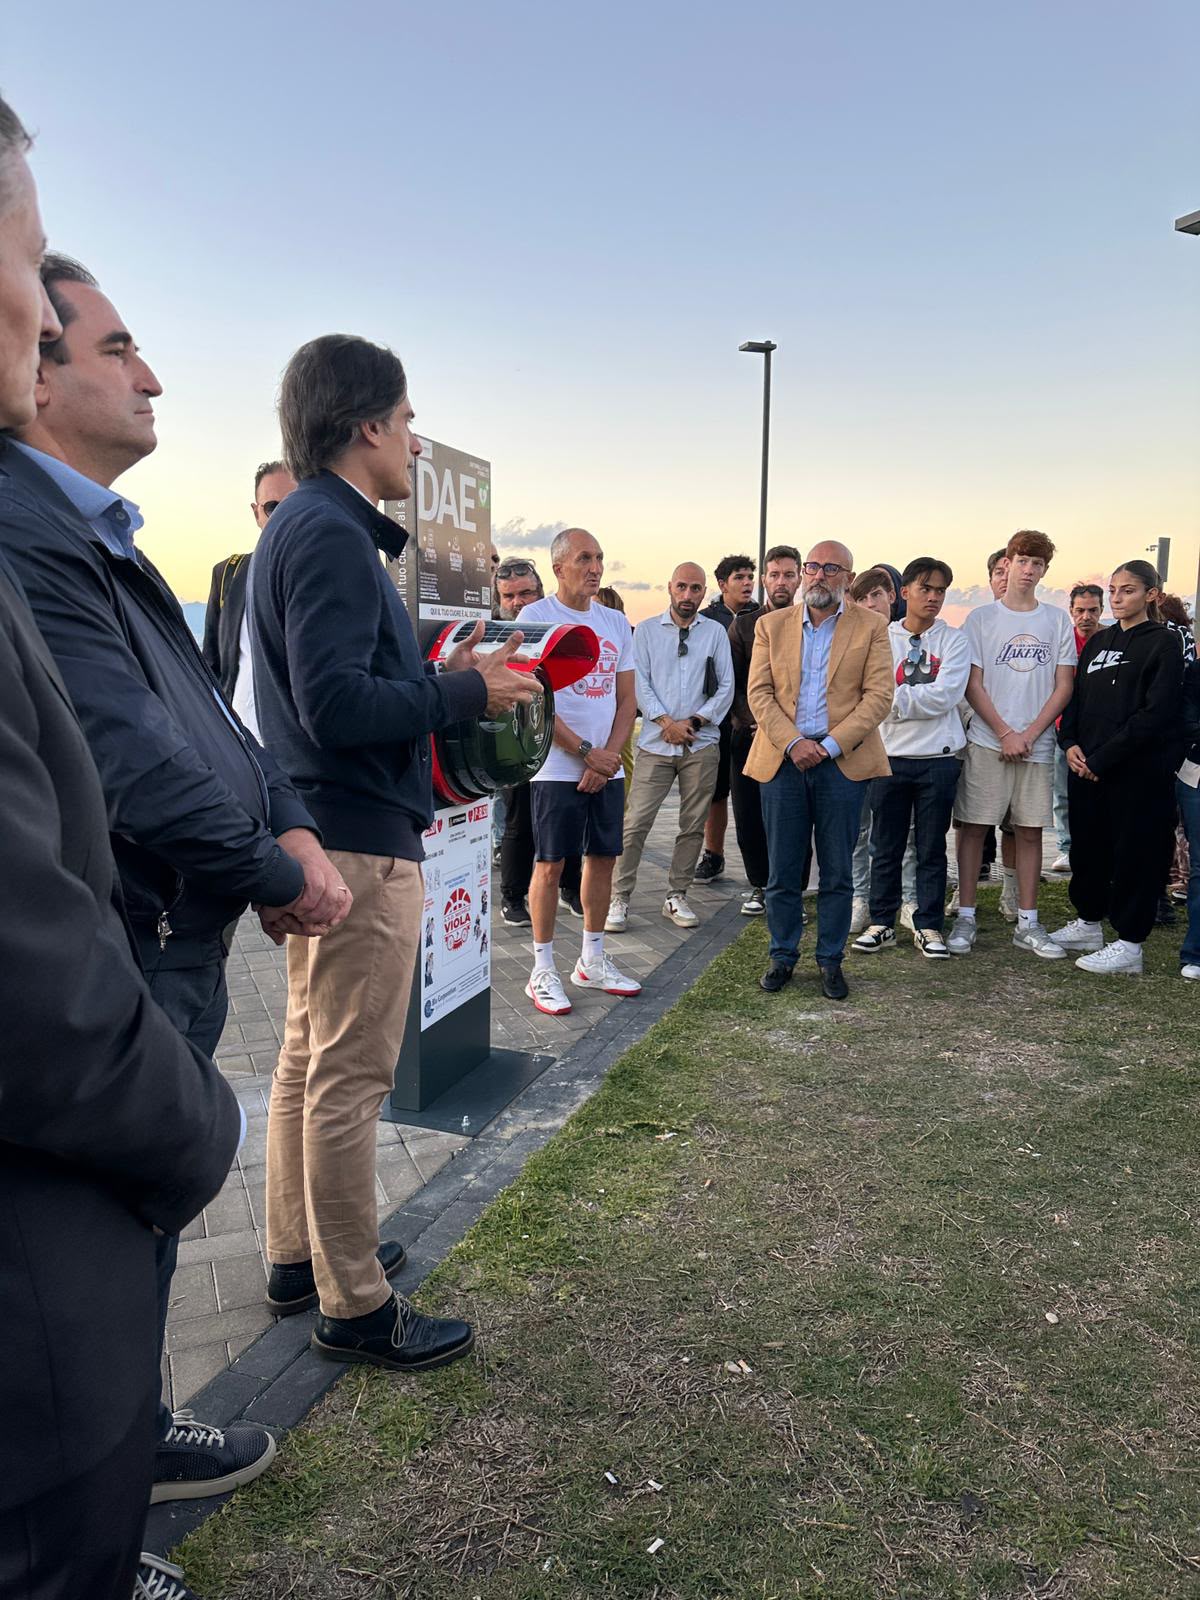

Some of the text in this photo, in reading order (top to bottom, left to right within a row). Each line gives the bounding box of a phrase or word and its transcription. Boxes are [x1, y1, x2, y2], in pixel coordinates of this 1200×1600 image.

[417, 458, 477, 532] DAE
[395, 511, 406, 521] al
[397, 567, 407, 585] tuo
[1001, 644, 1049, 663] LAKERS
[1093, 649, 1124, 663] NIKE
[444, 912, 471, 933] VIOLA
